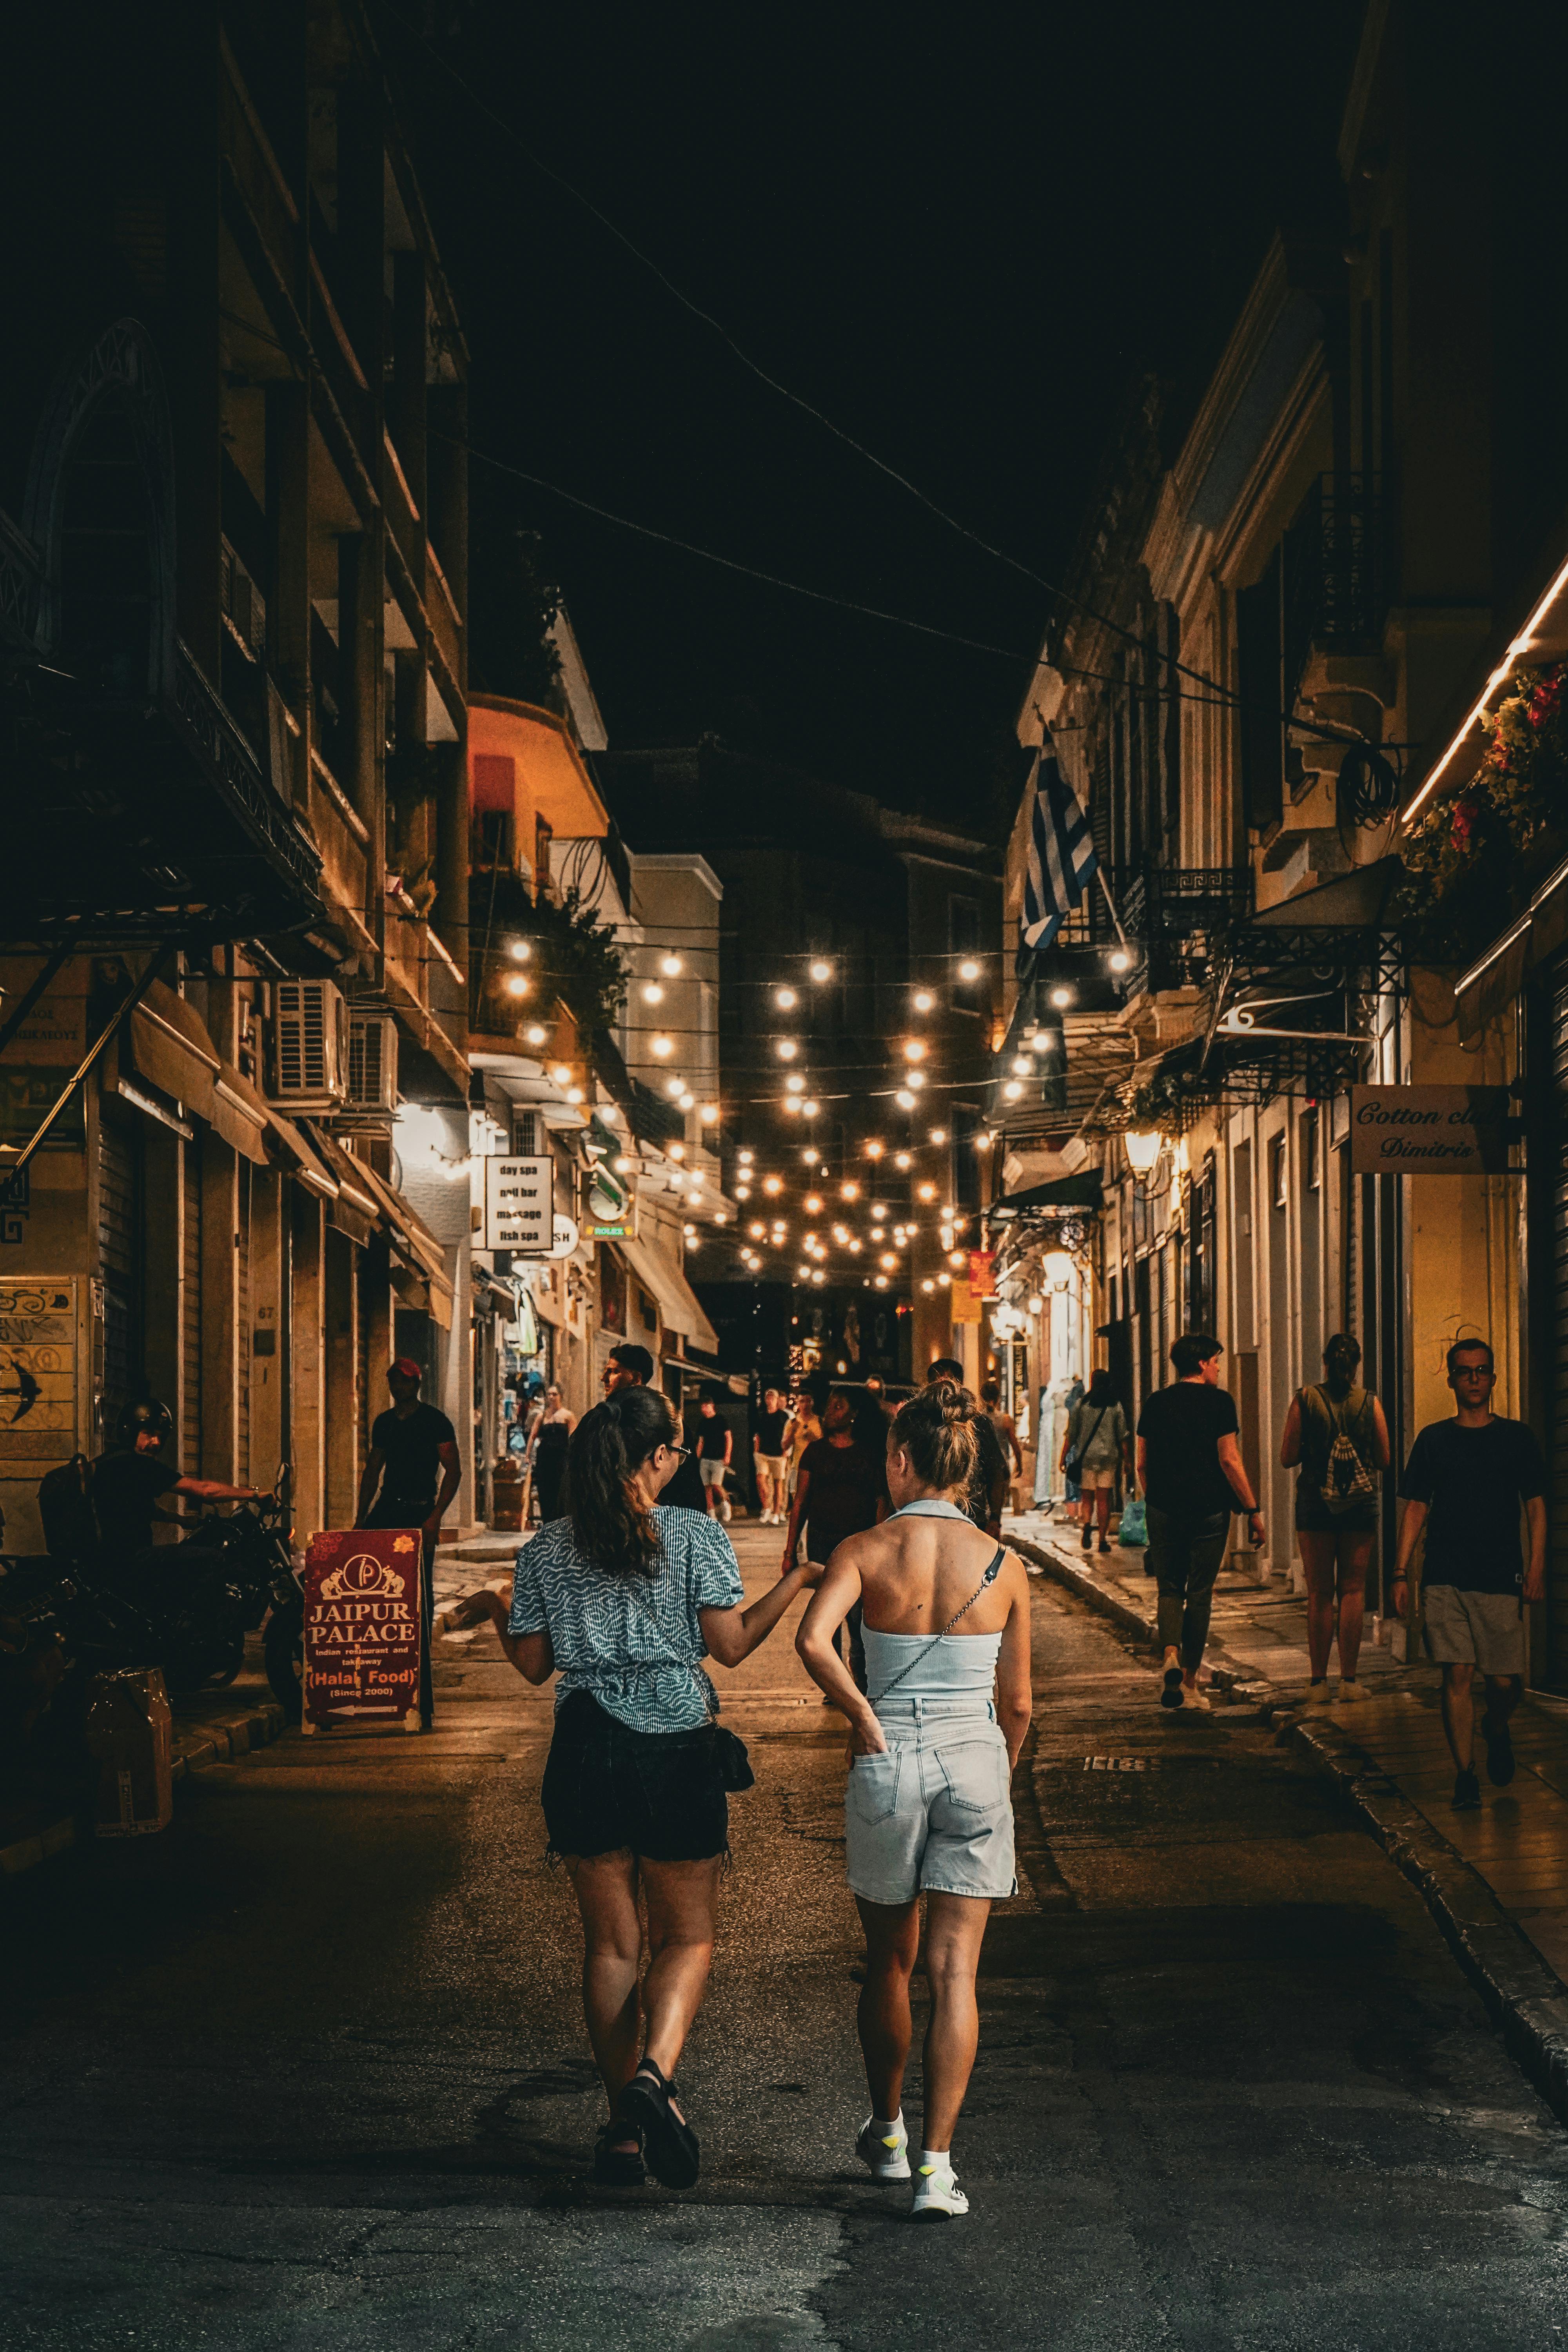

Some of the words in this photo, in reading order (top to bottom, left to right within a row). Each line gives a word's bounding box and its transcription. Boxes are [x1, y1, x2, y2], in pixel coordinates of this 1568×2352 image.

[31, 1009, 54, 1019] ΔΟΣ
[1357, 1102, 1443, 1124] Cotton
[1380, 1137, 1473, 1157] Dimitris
[500, 1166, 517, 1176] day
[520, 1167, 537, 1175] spa
[521, 1188, 537, 1197] bar
[500, 1232, 518, 1241] fish
[521, 1232, 539, 1241] spa
[553, 1233, 570, 1242] SH
[259, 1307, 274, 1319] 67
[309, 1603, 410, 1623] JAIPUR
[309, 1624, 415, 1644] PALACE
[369, 1669, 414, 1686] Food)
